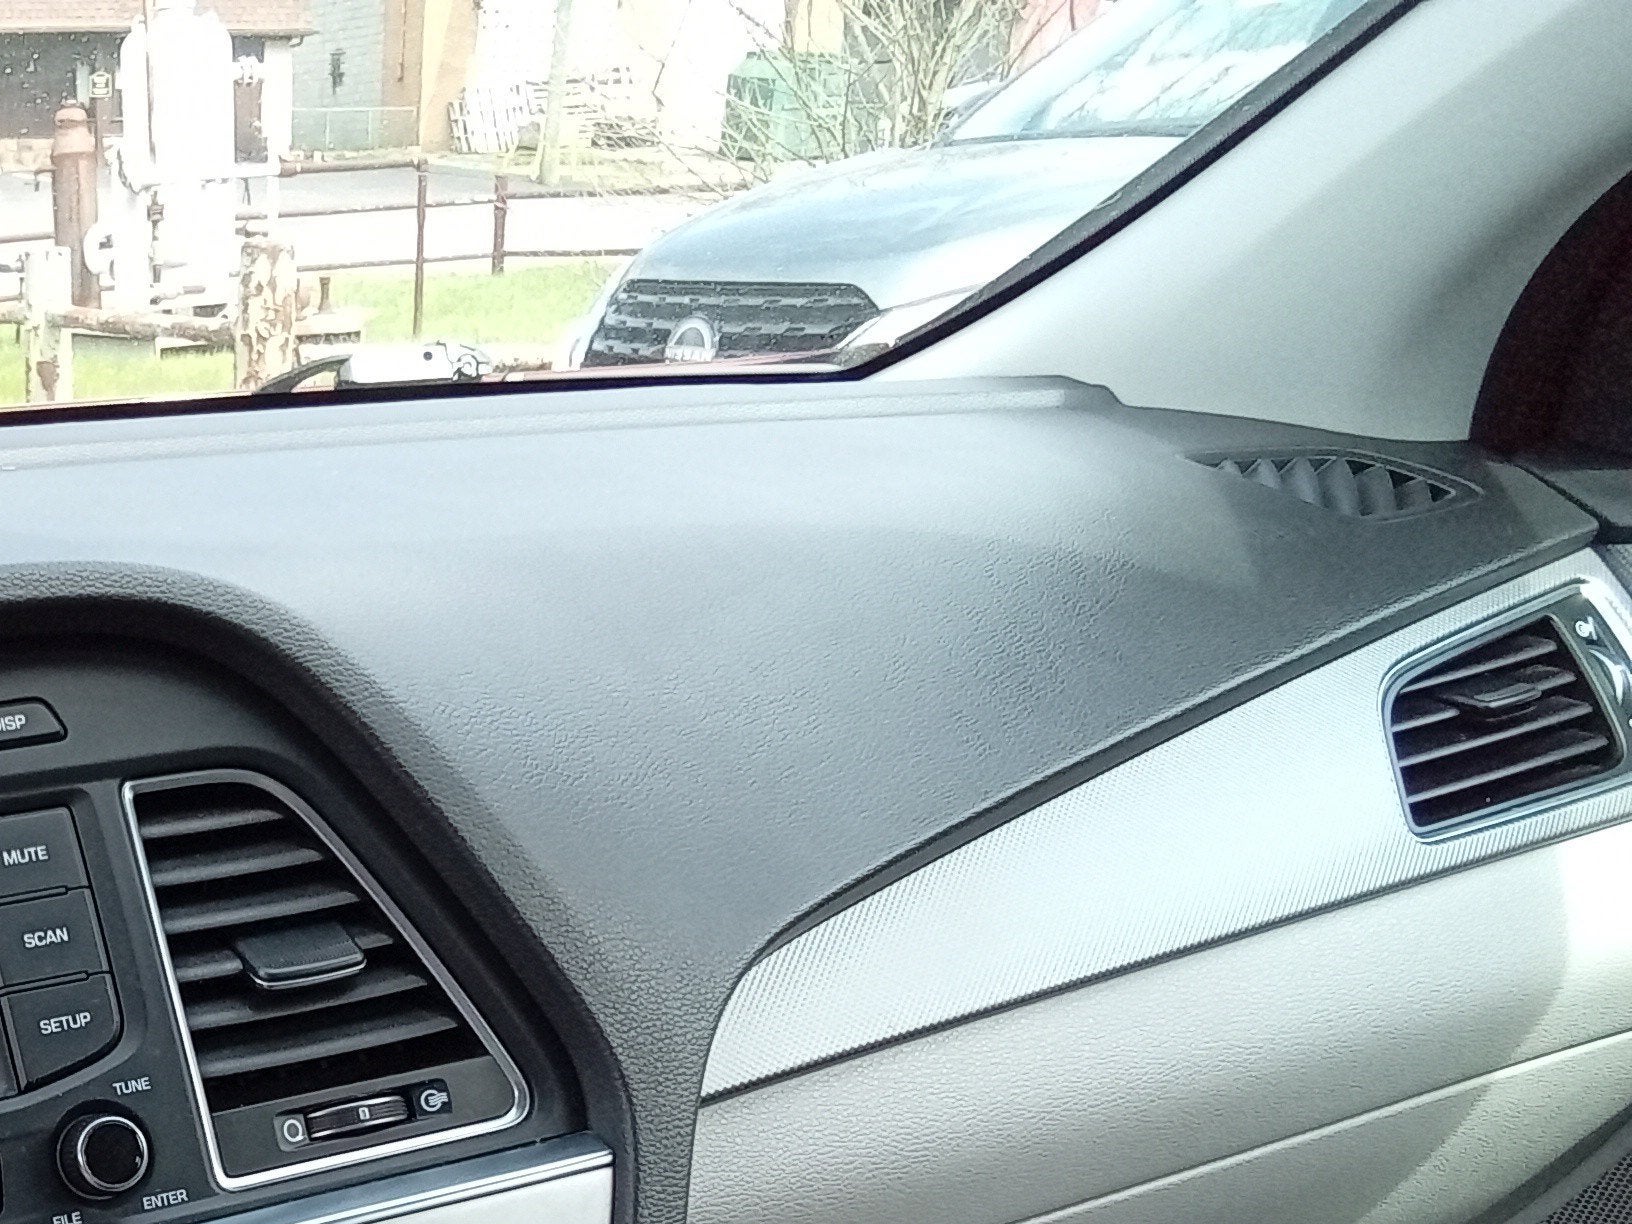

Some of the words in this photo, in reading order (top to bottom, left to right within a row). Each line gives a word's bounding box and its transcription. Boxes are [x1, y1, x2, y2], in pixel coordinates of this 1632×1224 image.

[2, 845, 49, 866] MUTE
[23, 927, 69, 949] SCAN
[39, 1012, 91, 1035] SETUP
[111, 1077, 152, 1096] TUNE
[142, 1188, 189, 1210] ENTER
